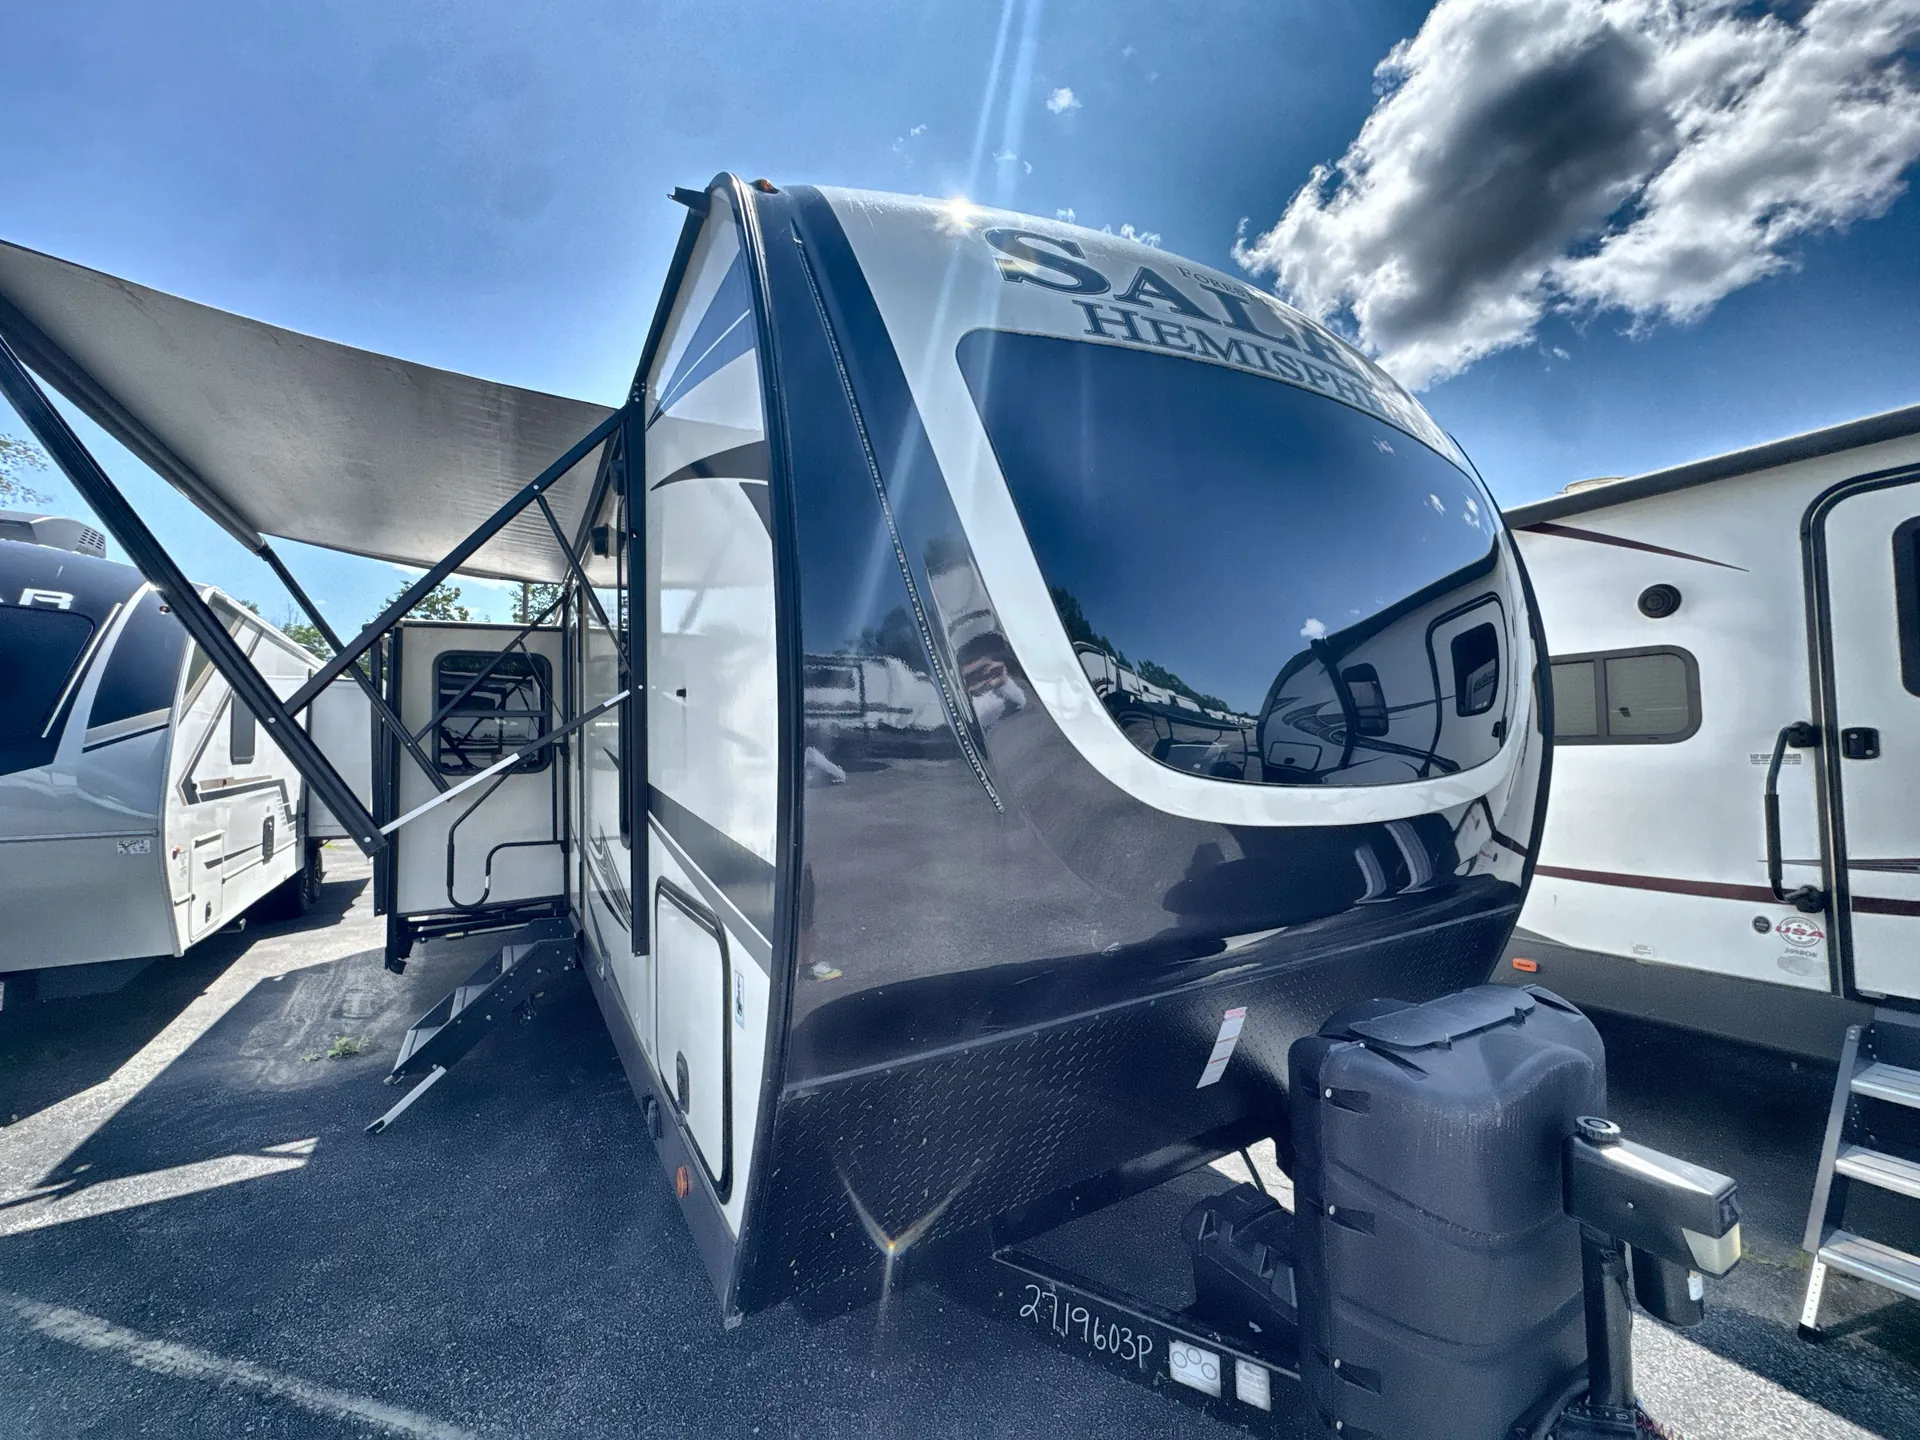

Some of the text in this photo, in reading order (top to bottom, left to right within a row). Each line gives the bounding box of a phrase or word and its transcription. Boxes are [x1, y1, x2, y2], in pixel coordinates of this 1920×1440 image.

[0, 588, 74, 609] R
[1775, 925, 1825, 938] USA
[1020, 1285, 1153, 1368] 2719603P
